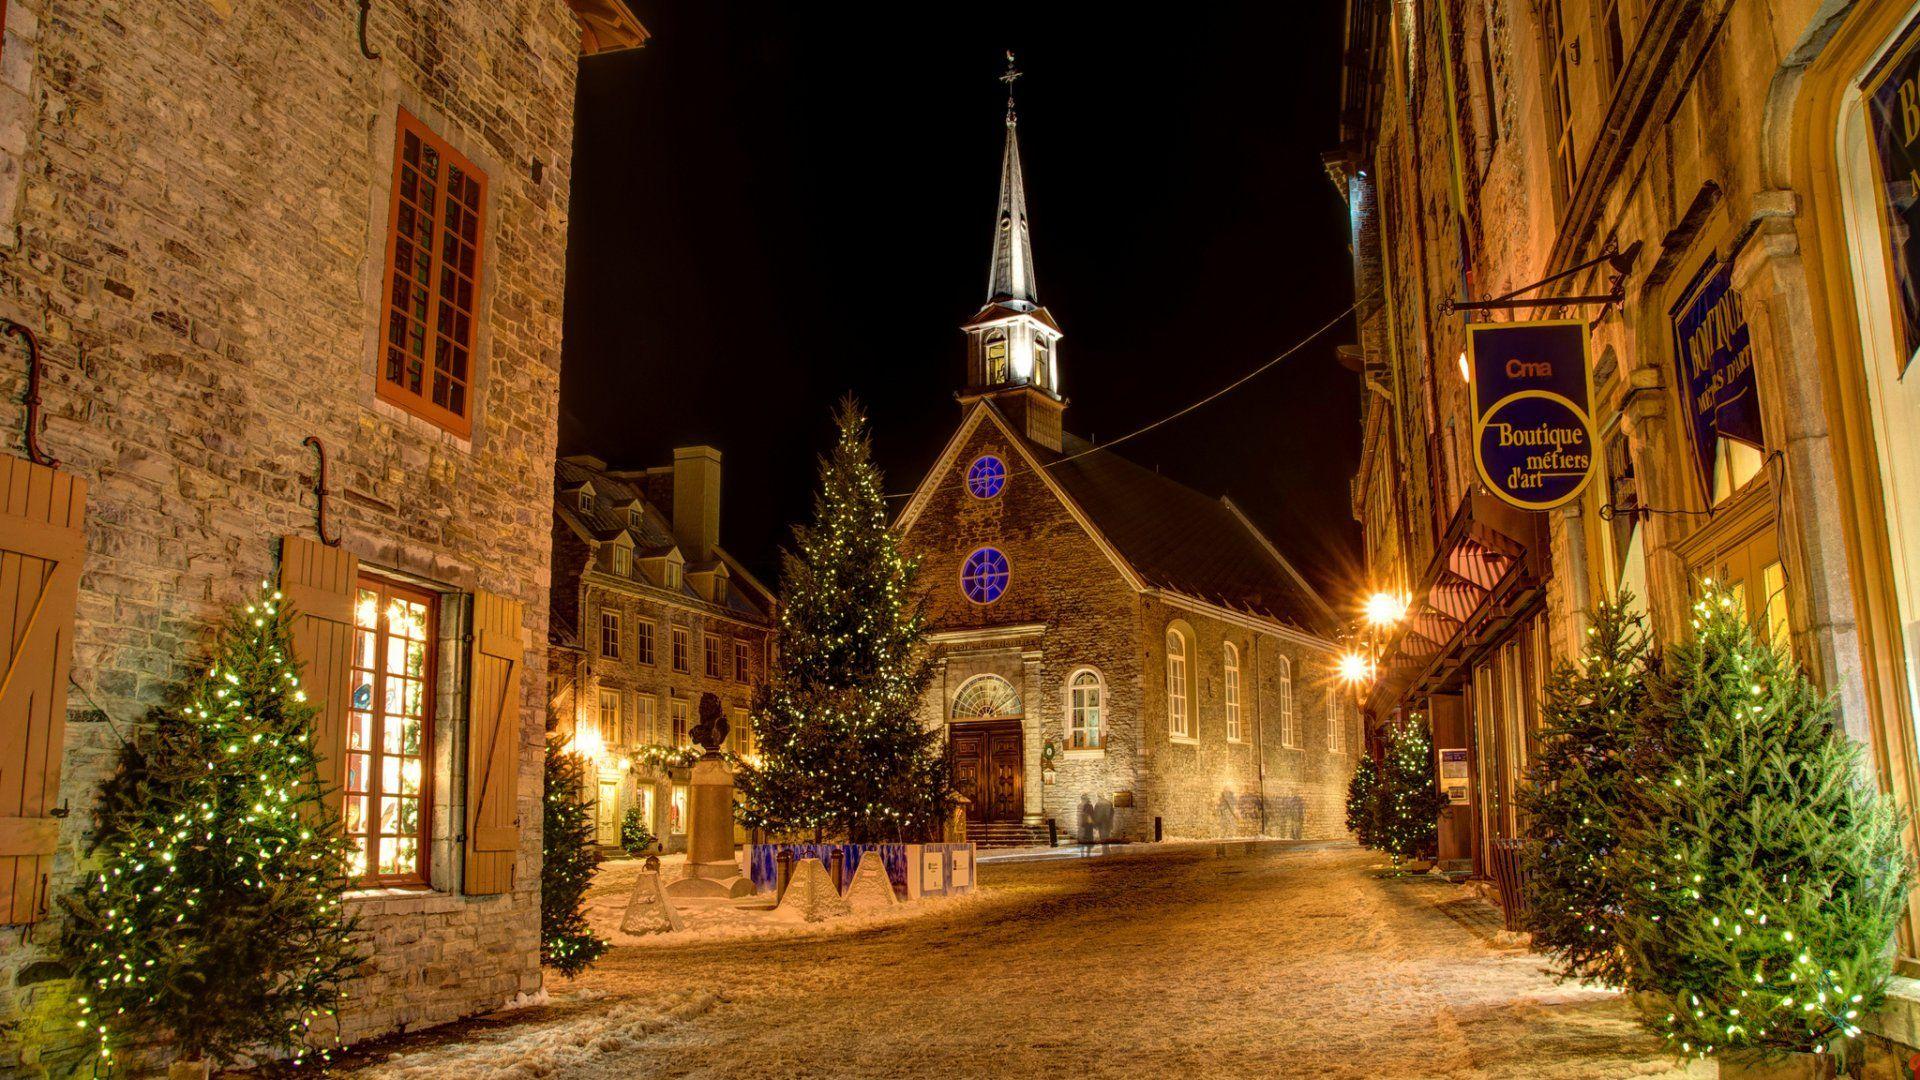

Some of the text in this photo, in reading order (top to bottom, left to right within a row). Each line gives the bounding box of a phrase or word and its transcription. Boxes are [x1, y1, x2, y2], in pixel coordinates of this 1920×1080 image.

[1498, 422, 1584, 453] Boutique
[1526, 450, 1589, 470] métiers
[1507, 467, 1544, 489] d'art
